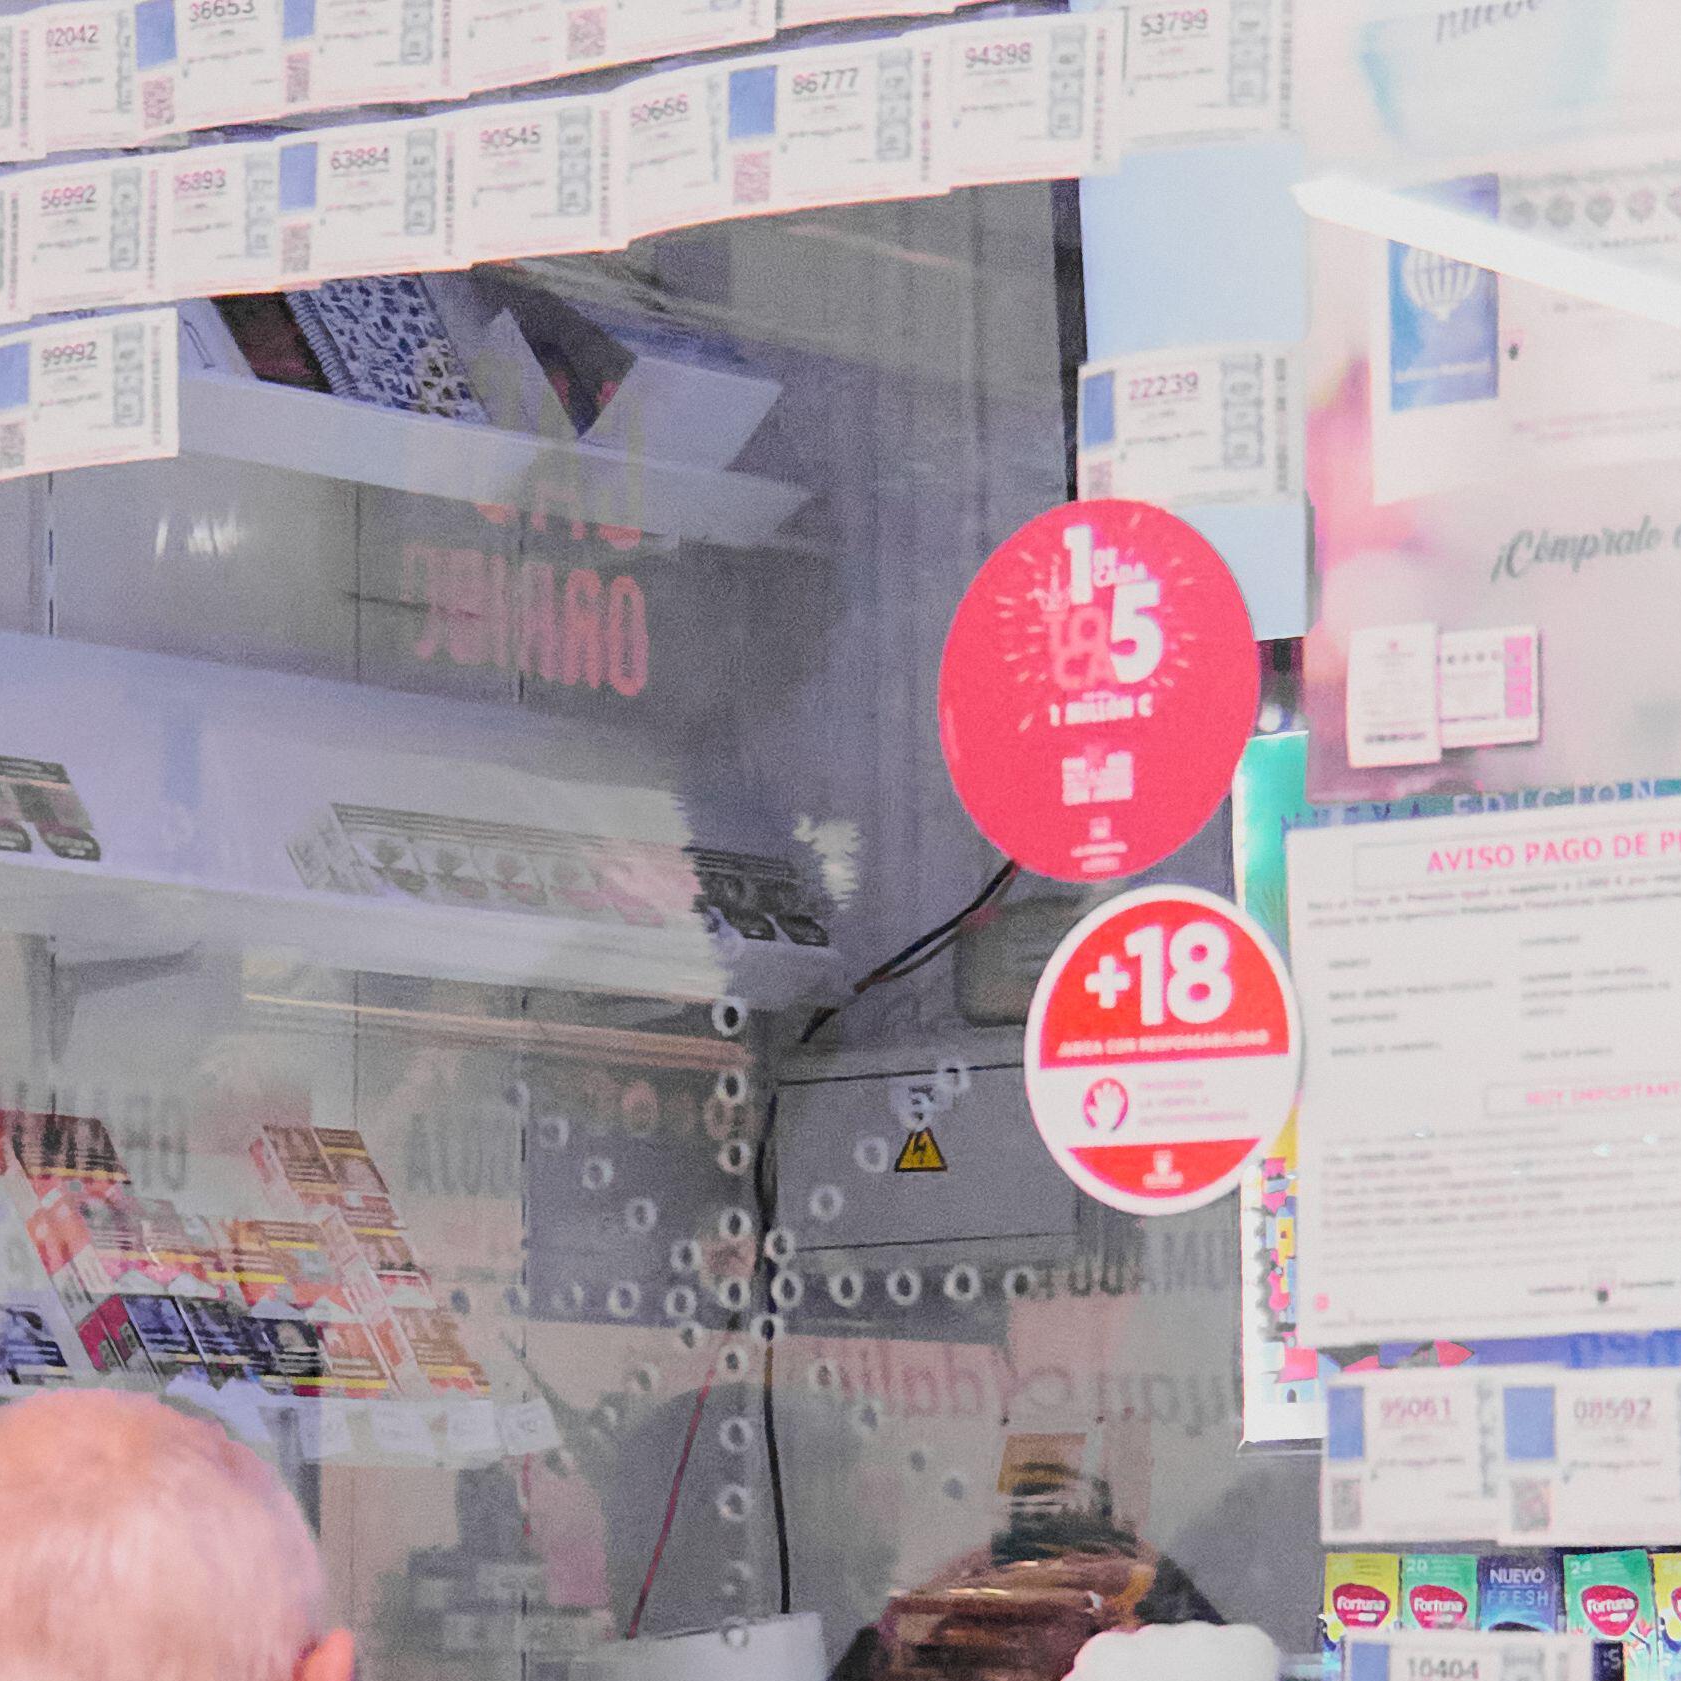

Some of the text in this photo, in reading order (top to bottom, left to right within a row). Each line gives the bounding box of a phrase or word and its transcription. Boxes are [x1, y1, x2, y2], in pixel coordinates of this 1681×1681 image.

[1110, 581, 1164, 683] 5
[1426, 845, 1515, 874] AVISO
[1525, 836, 1603, 866] PAGO
[1613, 833, 1648, 859] DE
[1084, 921, 1234, 1026] +18
[1490, 1567, 1545, 1584] NUEVO
[1488, 1591, 1550, 1607] FRESH
